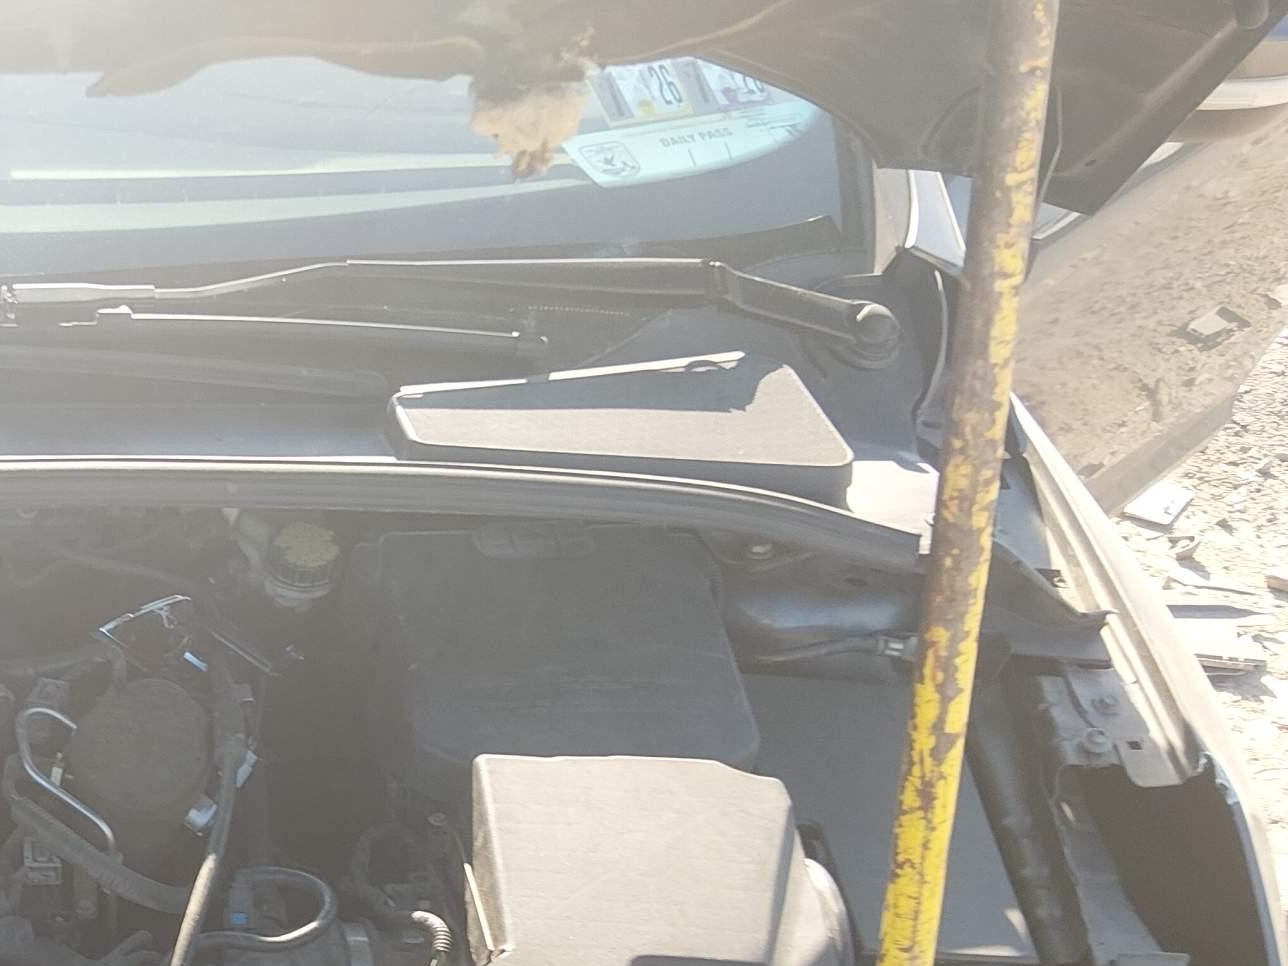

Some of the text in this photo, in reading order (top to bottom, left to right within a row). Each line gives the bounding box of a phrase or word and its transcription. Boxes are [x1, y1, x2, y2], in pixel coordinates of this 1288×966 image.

[647, 64, 683, 106] 26
[659, 127, 734, 148] DAILY PASS
